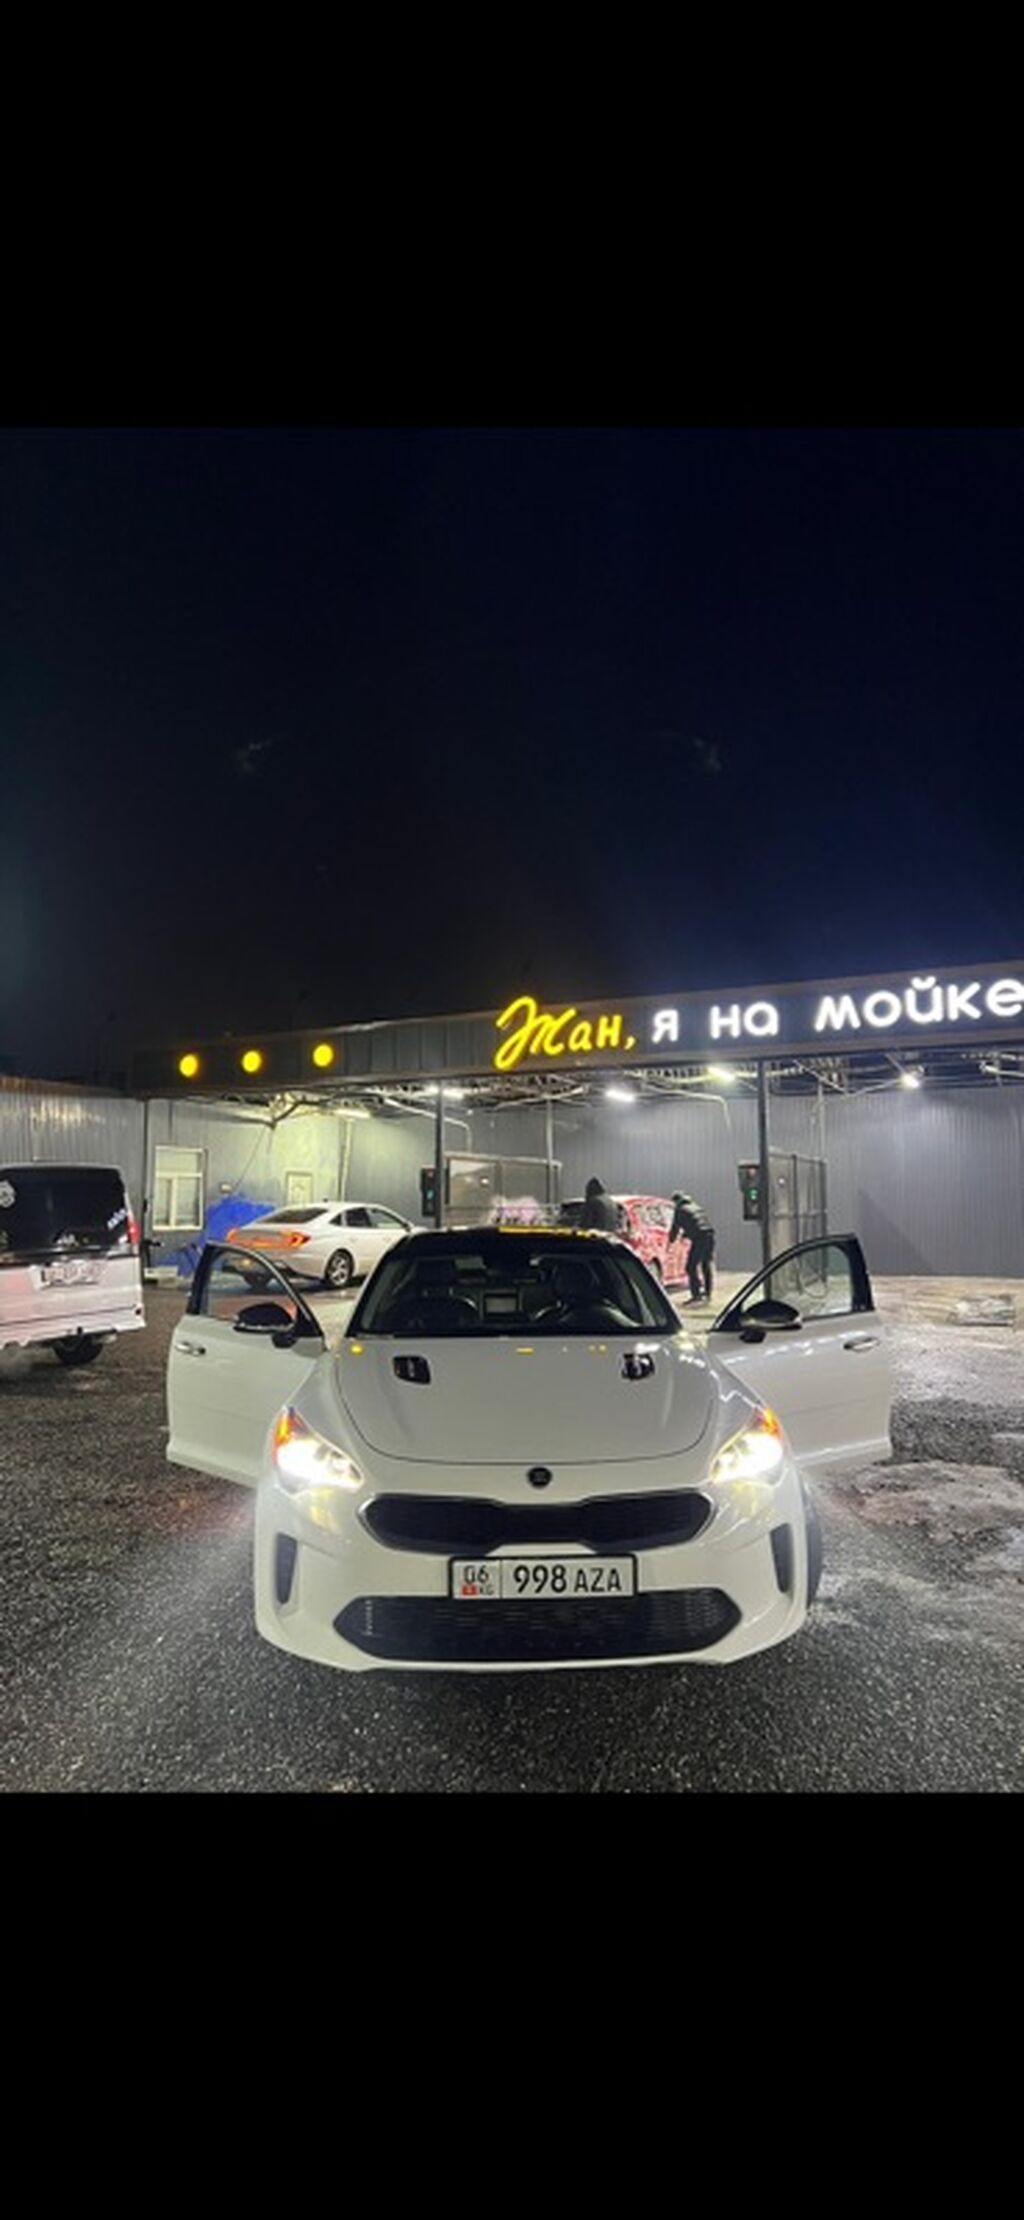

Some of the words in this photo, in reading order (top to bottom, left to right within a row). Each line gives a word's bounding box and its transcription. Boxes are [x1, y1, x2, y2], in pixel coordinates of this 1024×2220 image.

[494, 996, 636, 1070] Жан,
[651, 1008, 680, 1043] я
[709, 1002, 780, 1039] на
[814, 976, 1024, 1033] мойке
[463, 1565, 489, 1585] 06
[513, 1564, 568, 1594] 998
[574, 1567, 622, 1593] AZA
